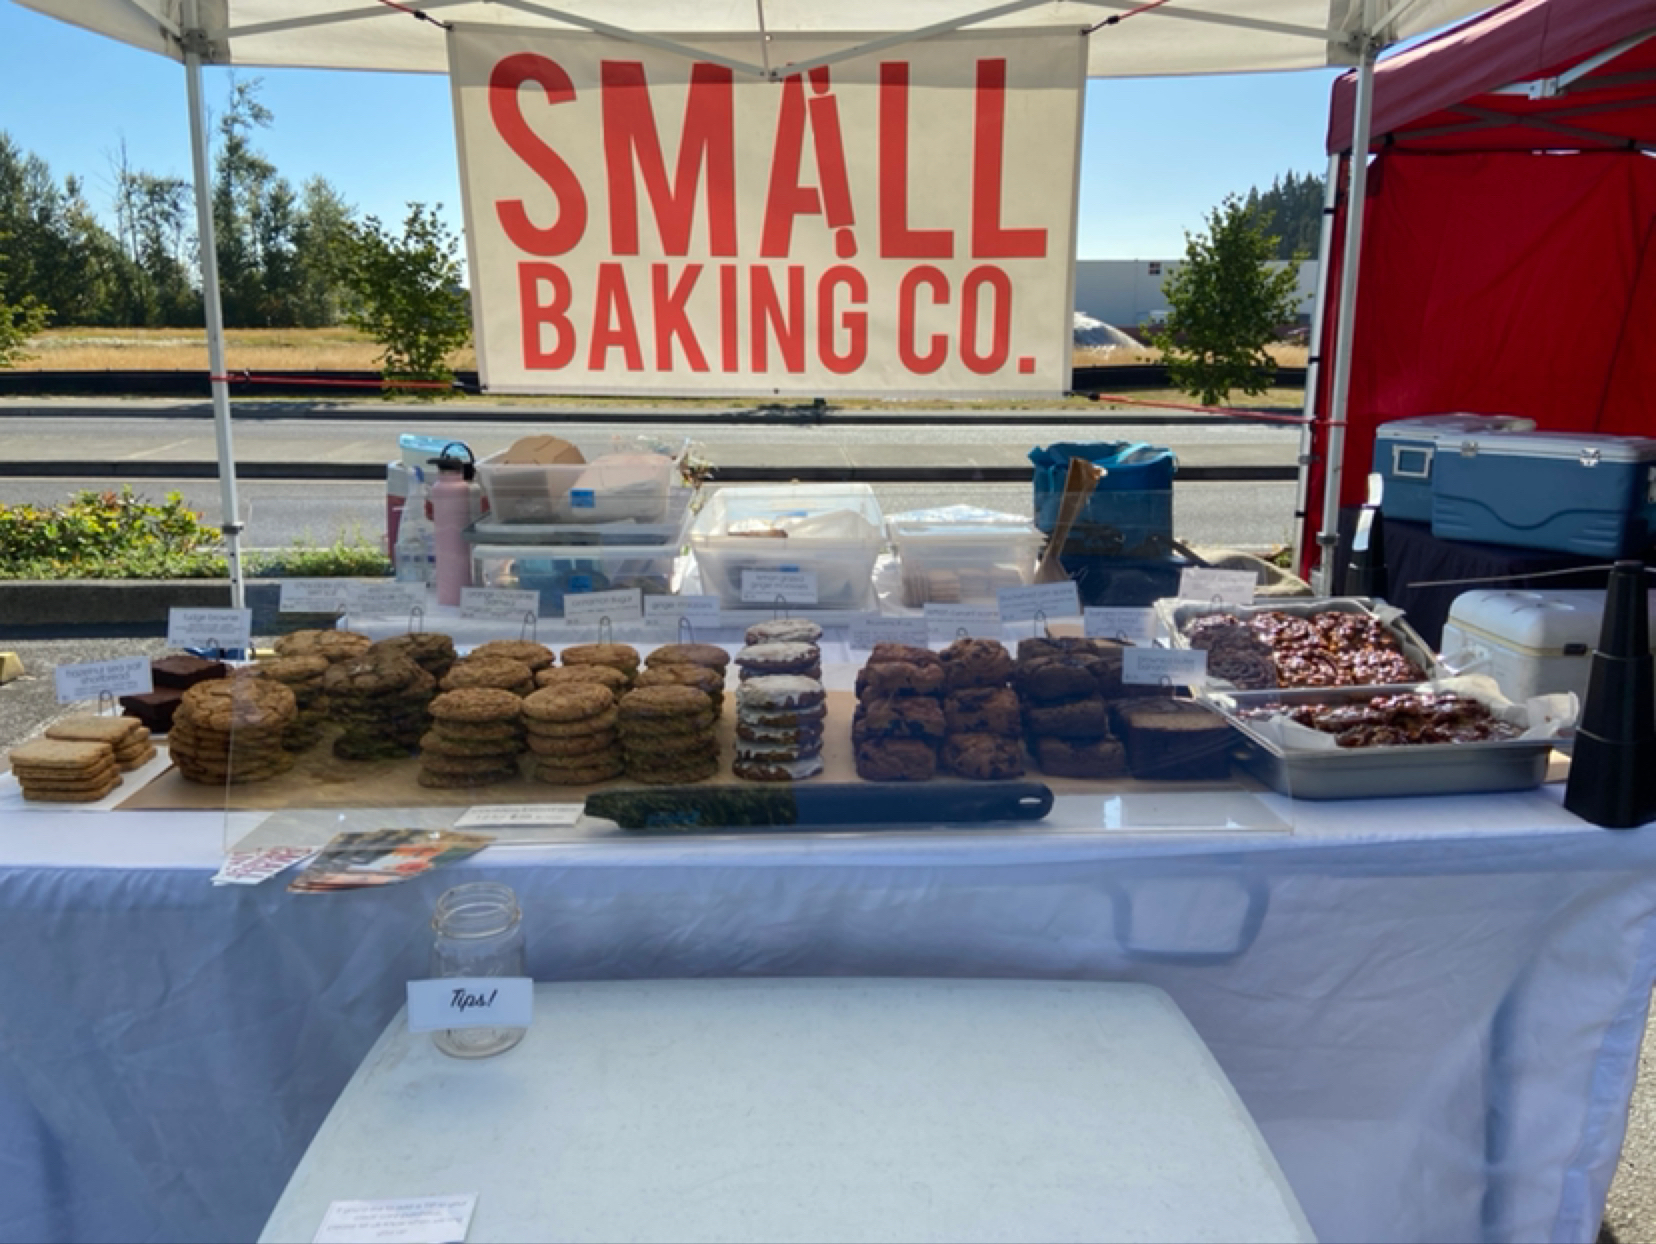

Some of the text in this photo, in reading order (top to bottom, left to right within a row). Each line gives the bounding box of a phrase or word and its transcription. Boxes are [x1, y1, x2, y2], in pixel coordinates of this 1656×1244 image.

[488, 51, 1048, 259] SMALL
[518, 261, 1037, 375] BAKING CO.
[450, 988, 498, 1013] Tips!
